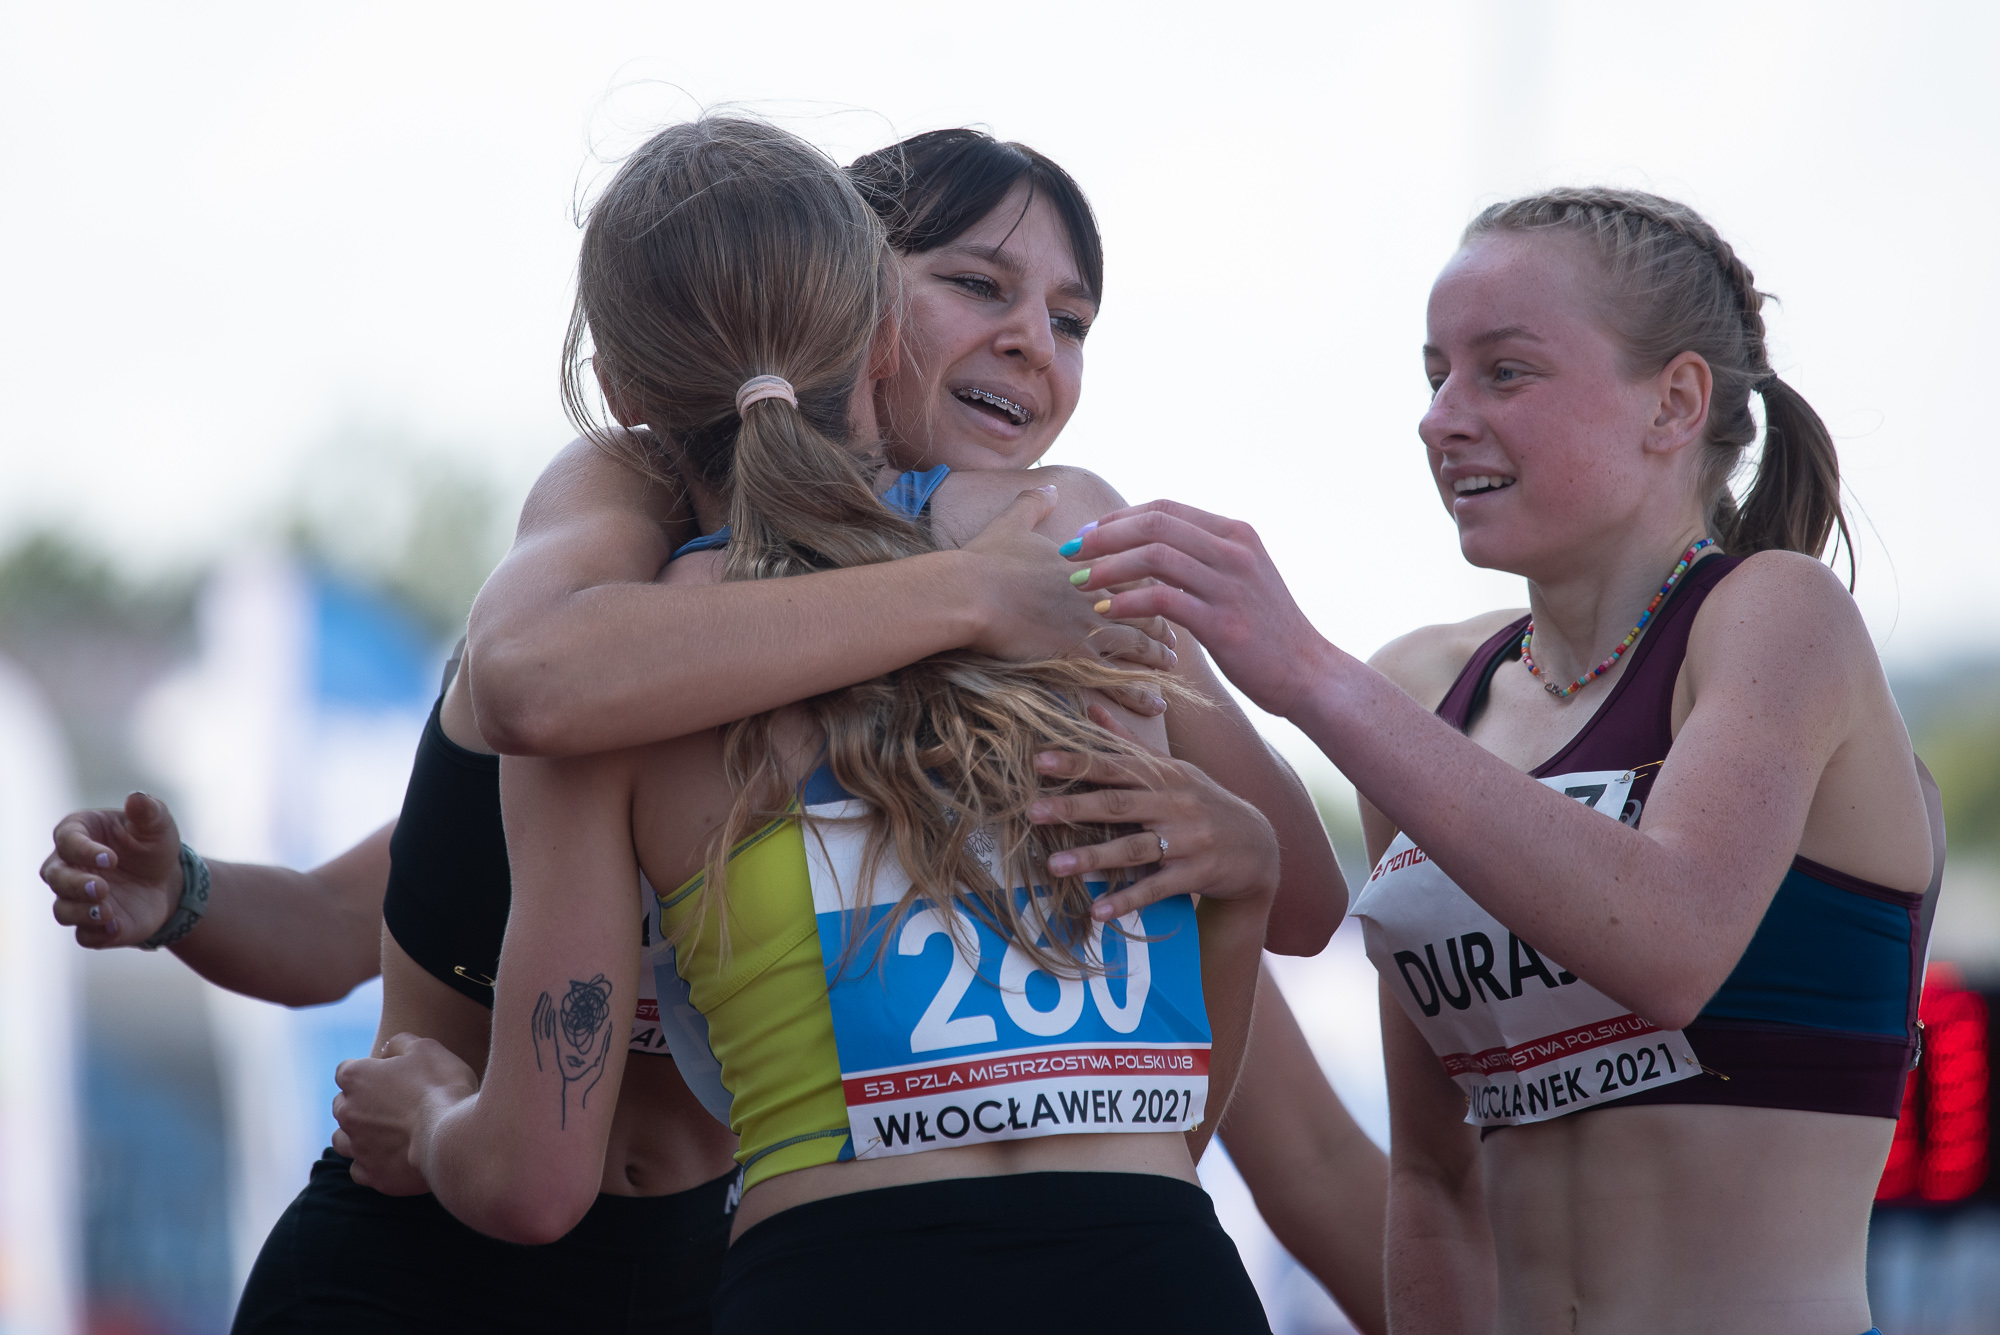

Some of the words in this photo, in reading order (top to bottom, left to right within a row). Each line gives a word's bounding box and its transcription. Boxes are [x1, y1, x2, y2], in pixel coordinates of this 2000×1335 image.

[897, 894, 1152, 1054] 260
[1393, 930, 1579, 1018] DURA
[1564, 1022, 1627, 1049] POLSKI
[864, 1079, 900, 1098] 53.
[906, 1071, 963, 1093] PZLA
[968, 1055, 1113, 1083] MISTRZOSTWA
[1114, 1055, 1167, 1070] POLSKI
[1168, 1055, 1194, 1070] U18
[1595, 1043, 1677, 1094] 2021
[873, 1088, 1124, 1148] WŁOCŁAWEK
[1132, 1088, 1192, 1124] 2021
